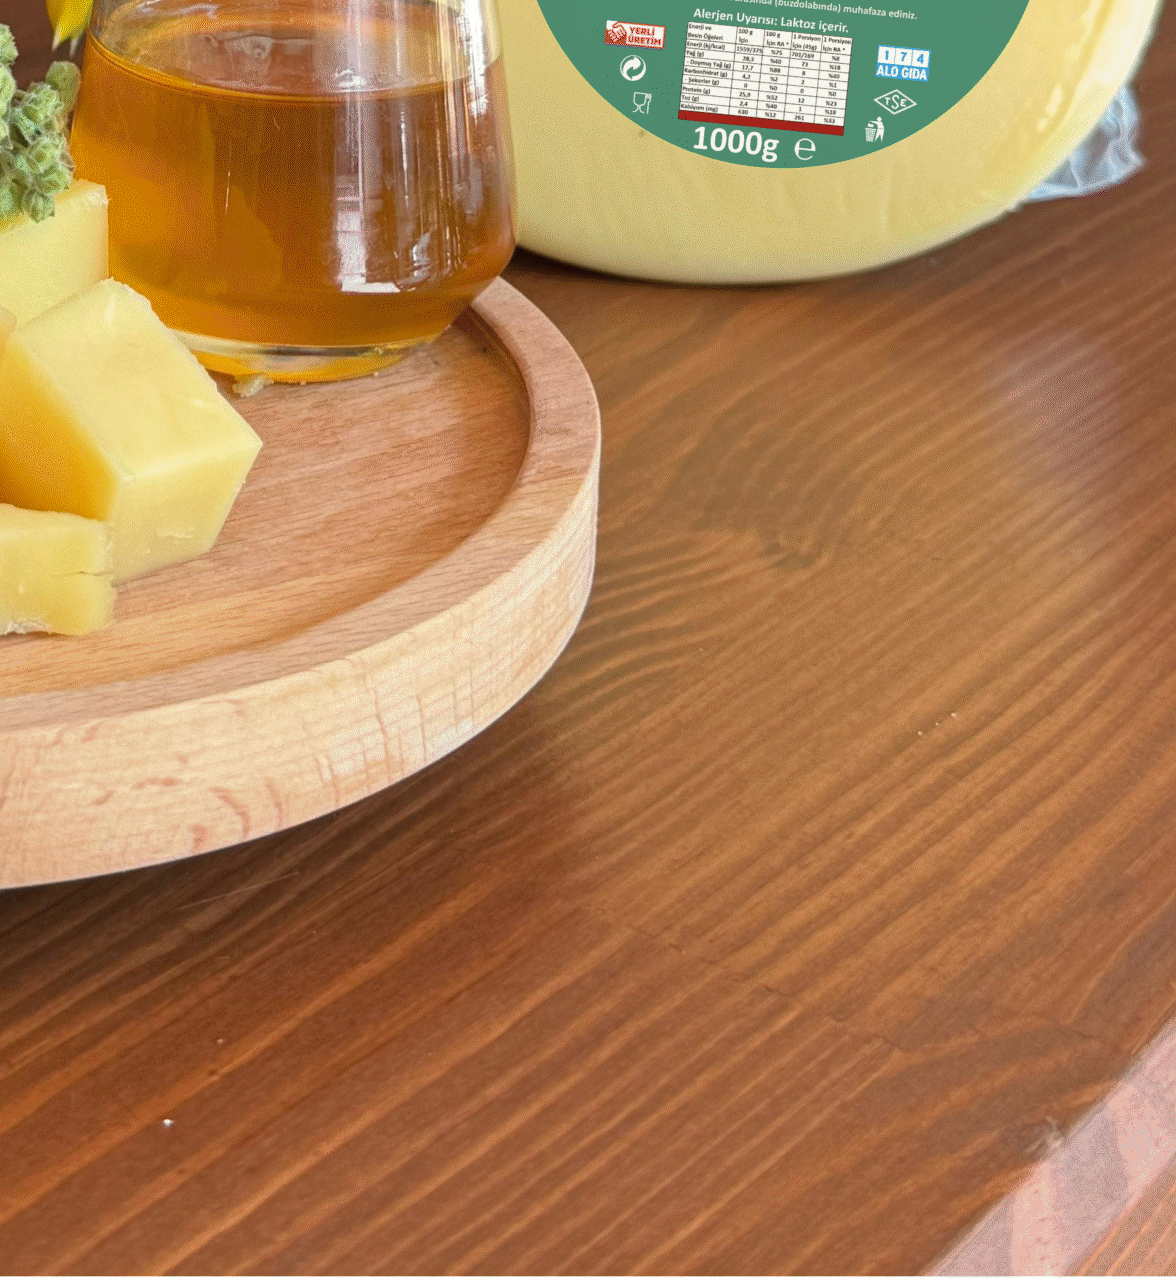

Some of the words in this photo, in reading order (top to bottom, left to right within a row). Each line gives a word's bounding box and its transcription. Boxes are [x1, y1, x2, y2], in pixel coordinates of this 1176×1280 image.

[693, 8, 734, 22] Alerjen
[736, 12, 778, 26] Uyarısı:
[781, 17, 816, 30] Laktoz
[818, 20, 849, 33] içerir.
[843, 5, 887, 17] muhafaza
[888, 9, 917, 20] ediniz.
[876, 64, 901, 78] ALO
[900, 66, 928, 81] GIDA
[884, 94, 907, 110] TSE
[693, 126, 780, 163] 1000g
